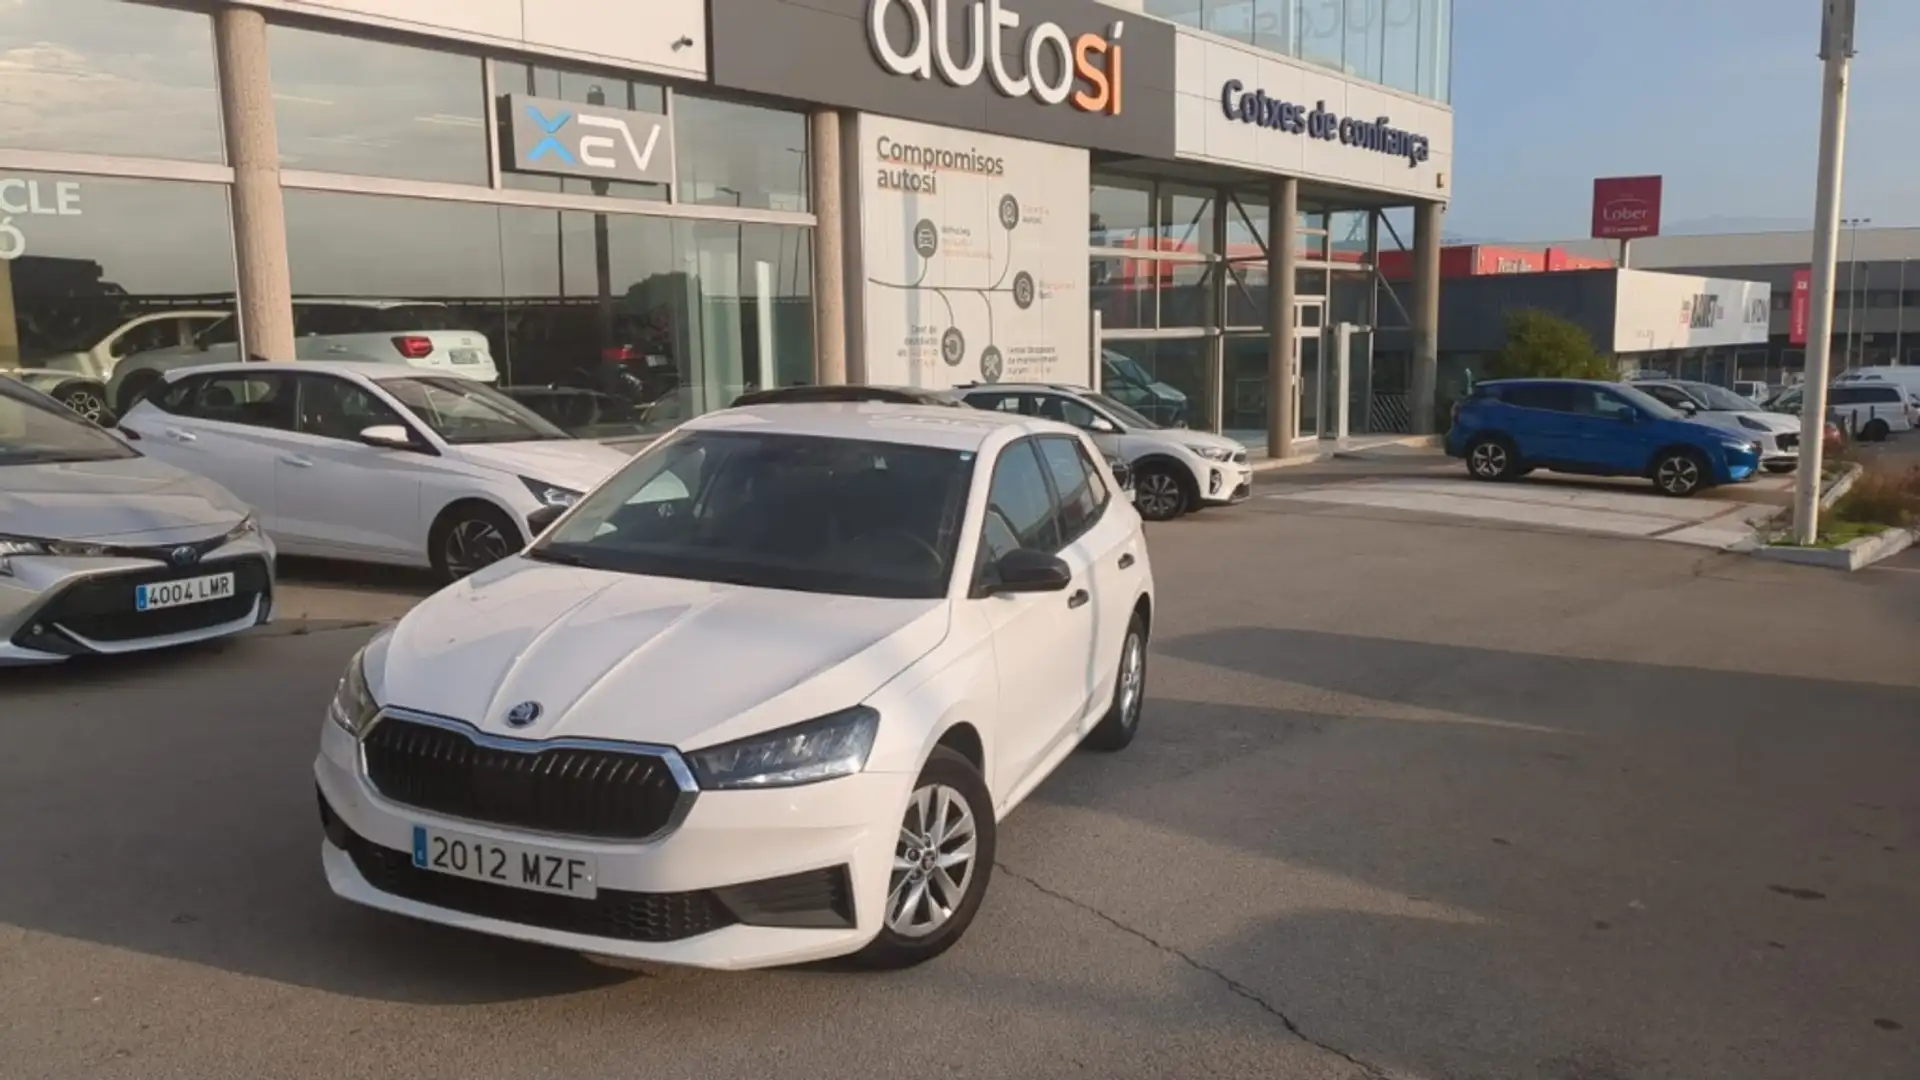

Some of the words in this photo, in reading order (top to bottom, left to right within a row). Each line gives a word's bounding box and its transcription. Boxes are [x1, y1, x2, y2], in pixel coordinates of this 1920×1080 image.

[866, 0, 1124, 116] autosí
[526, 104, 661, 171] XEV
[1221, 79, 1305, 134] Cotxes
[1308, 100, 1337, 141] de
[1339, 116, 1429, 168] confiança
[877, 136, 1004, 176] Compromisos
[877, 168, 937, 194] autosí
[1602, 206, 1648, 220] Lober
[149, 581, 193, 605] 4004
[199, 576, 230, 598] LMR
[433, 836, 507, 879] 2012
[521, 852, 586, 890] MZF
